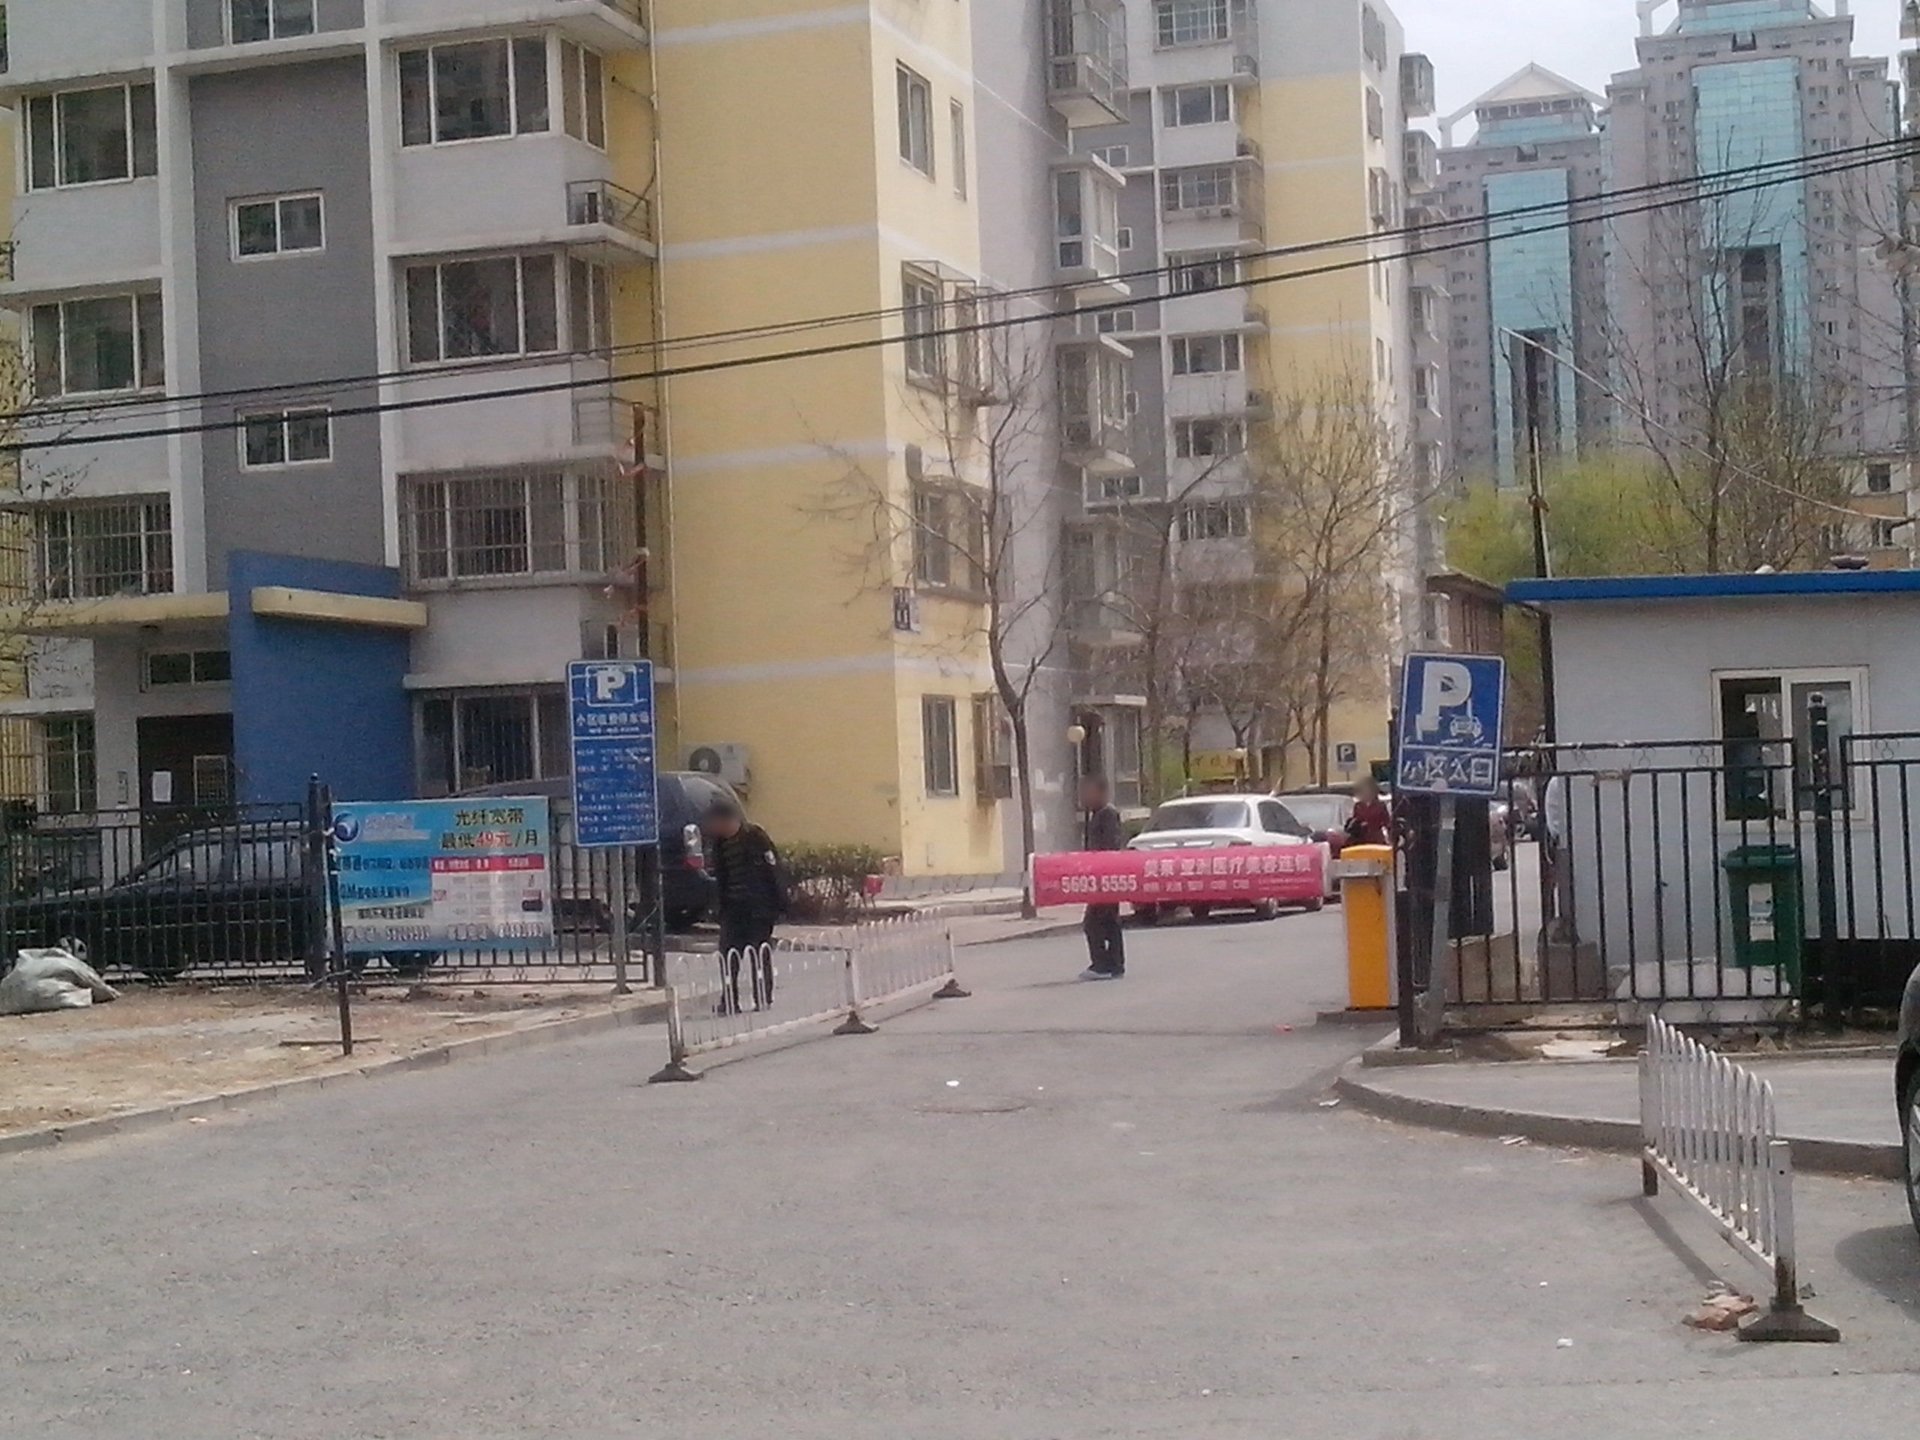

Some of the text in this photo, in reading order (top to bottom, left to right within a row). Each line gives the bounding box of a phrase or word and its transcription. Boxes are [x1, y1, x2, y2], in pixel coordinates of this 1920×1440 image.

[597, 669, 625, 699] P
[1421, 661, 1472, 731] P
[1341, 746, 1353, 762] P
[455, 807, 524, 827] 光纤宽带
[1061, 874, 1098, 893] 5693
[1101, 873, 1138, 892] 5555
